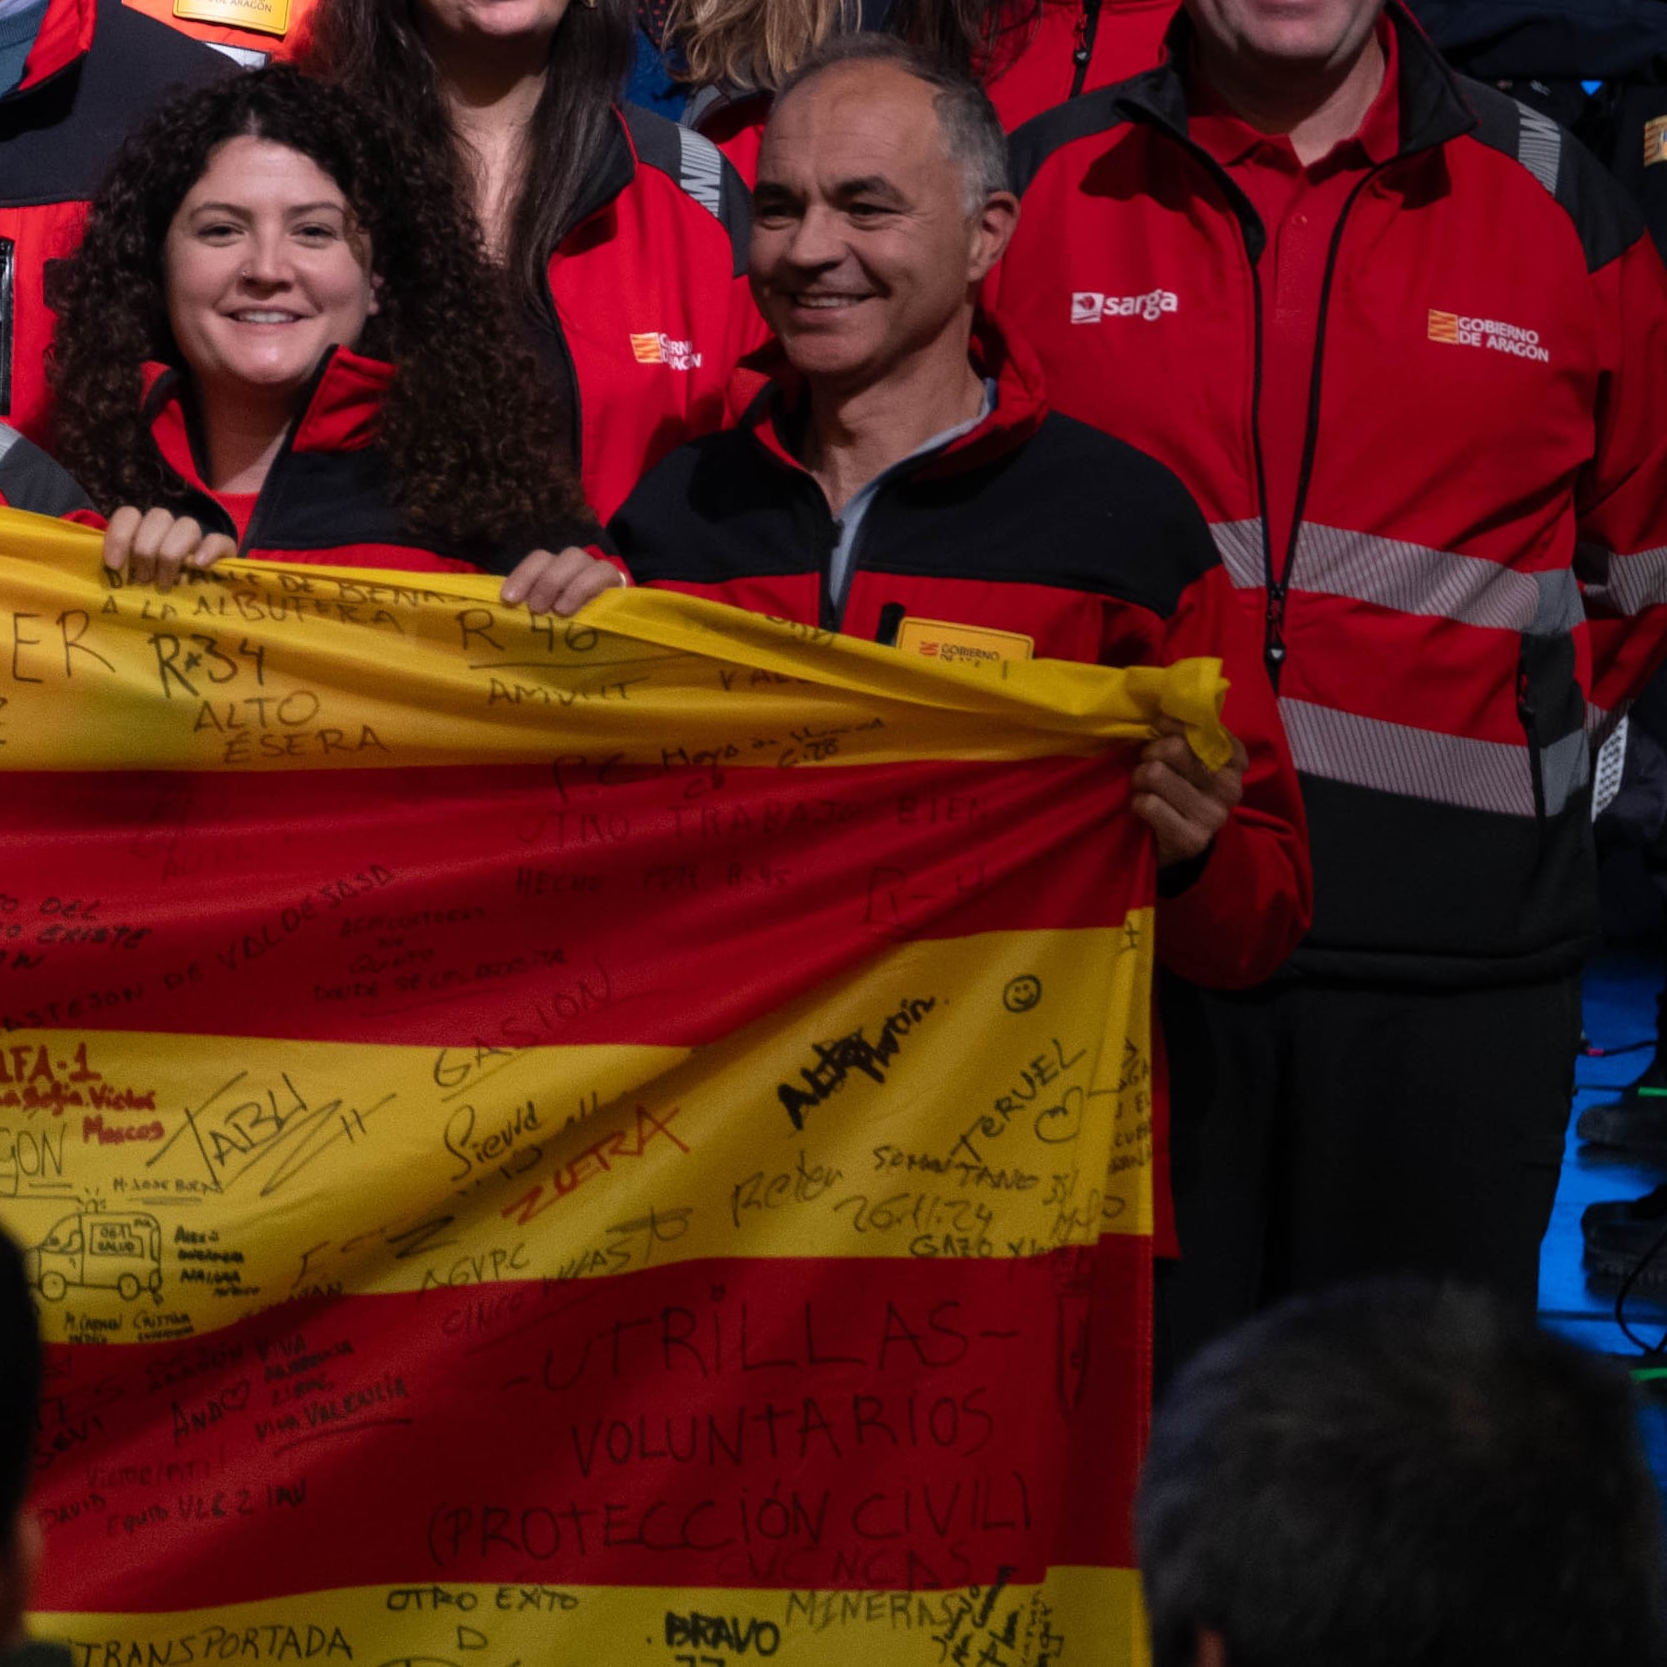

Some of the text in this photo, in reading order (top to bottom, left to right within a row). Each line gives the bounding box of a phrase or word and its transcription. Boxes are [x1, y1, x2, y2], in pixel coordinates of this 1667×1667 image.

[1102, 288, 1179, 323] sarga
[1457, 315, 1540, 346] GOBIERNO
[1457, 331, 1482, 348] DE
[940, 643, 1000, 661] GOBIERNO
[192, 687, 321, 734] ALTO
[570, 1384, 994, 1479] VOLUNTARIOS
